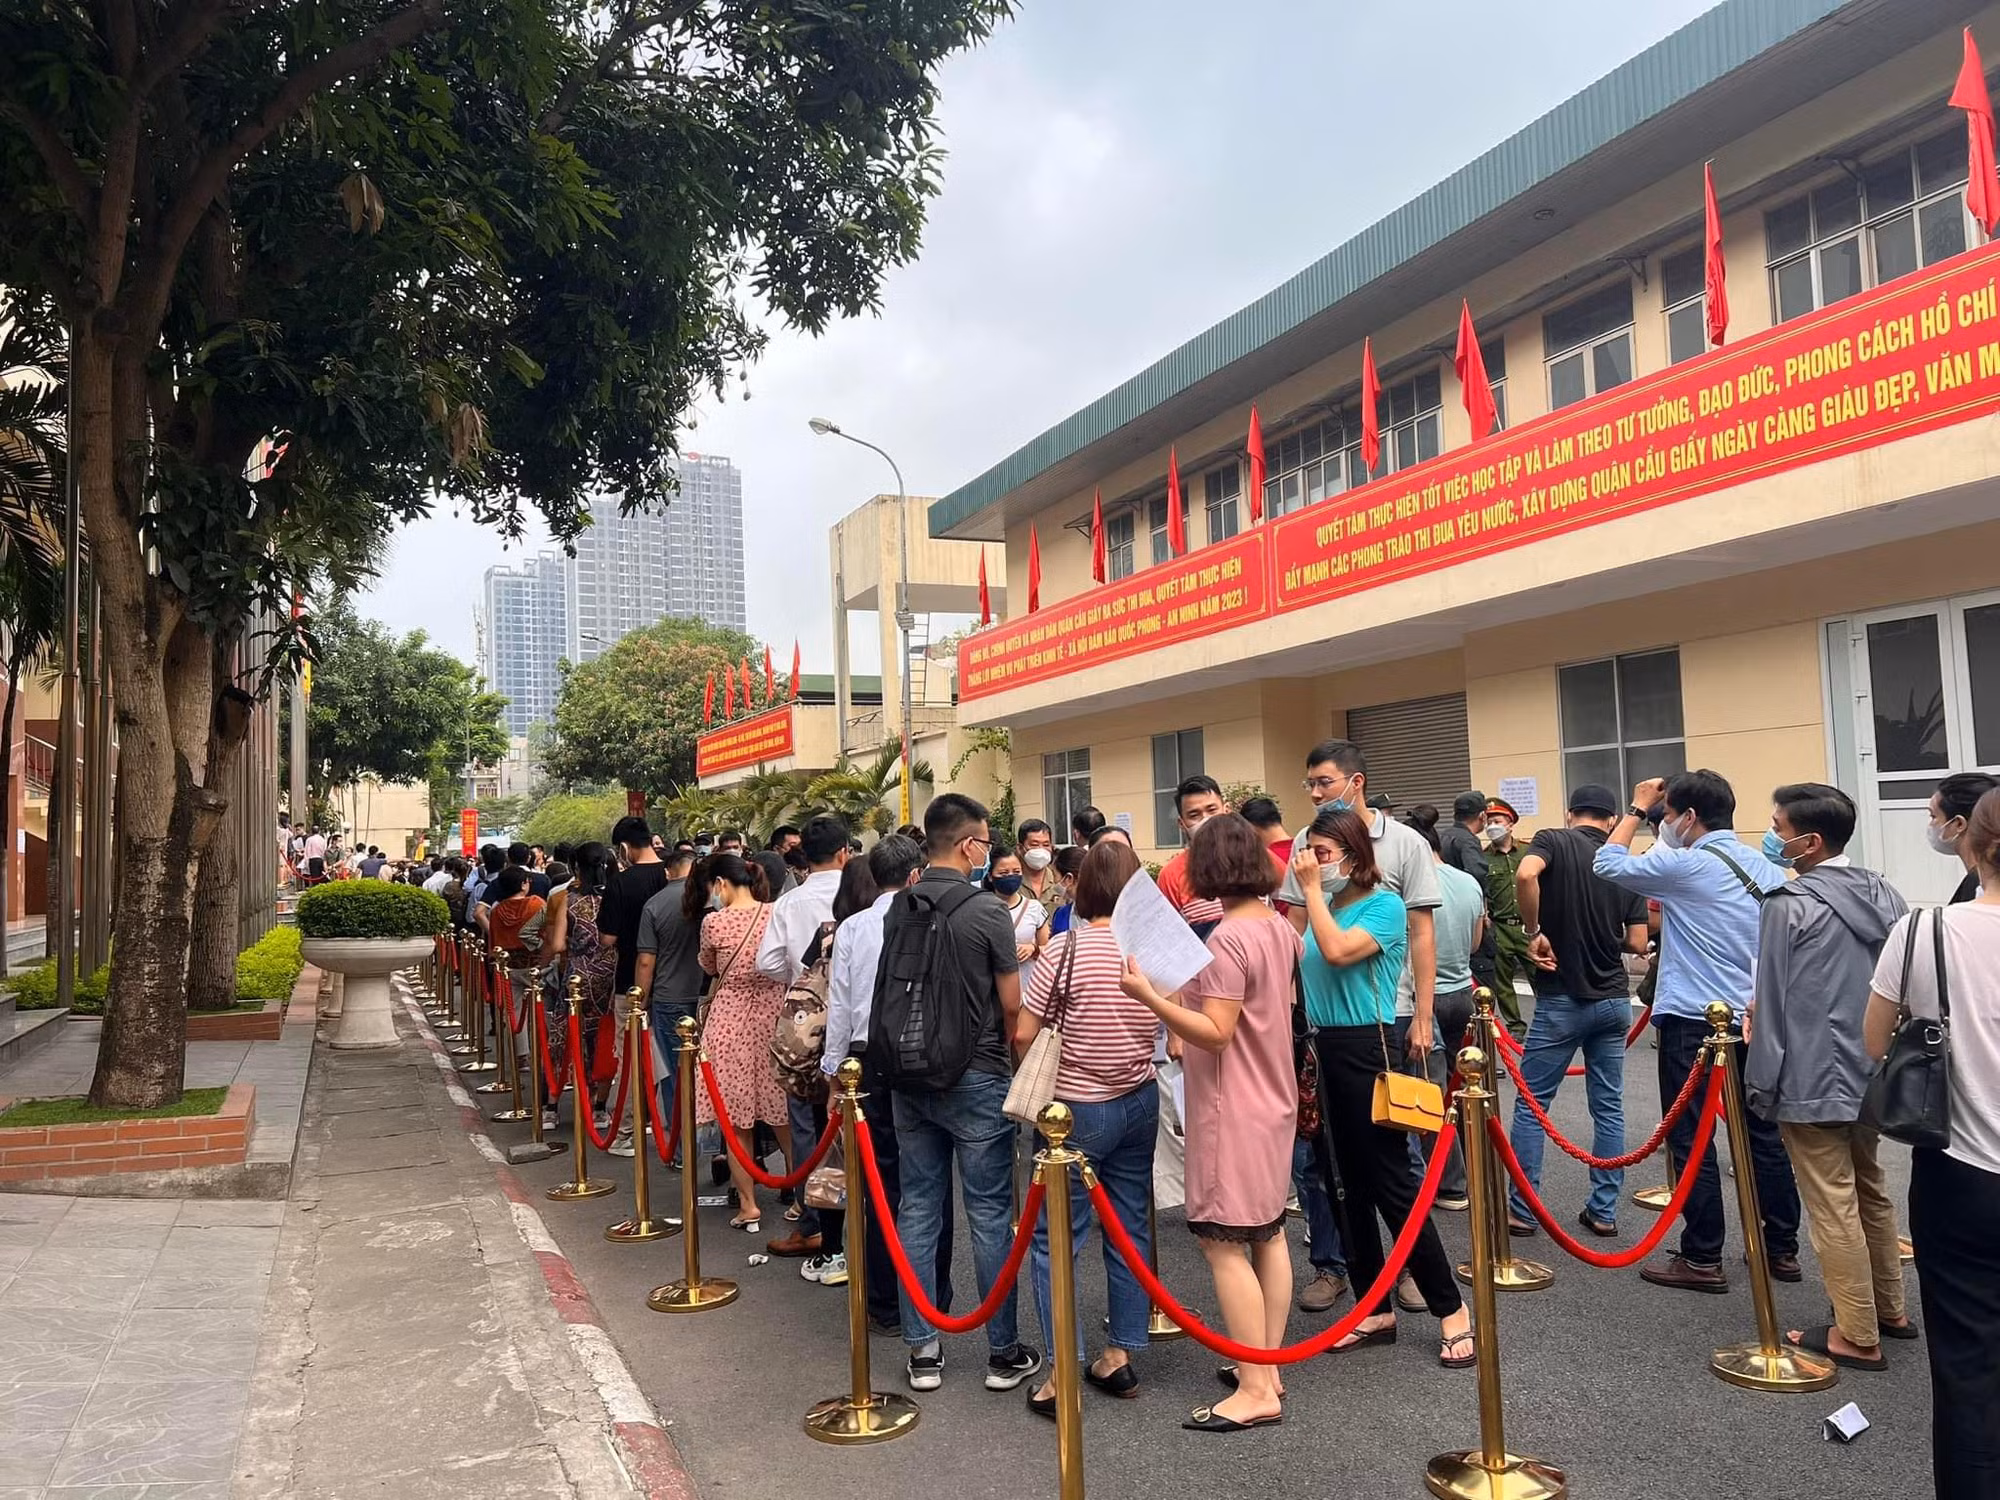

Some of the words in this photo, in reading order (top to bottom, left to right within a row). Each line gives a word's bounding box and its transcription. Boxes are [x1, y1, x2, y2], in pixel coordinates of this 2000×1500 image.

[1303, 558, 1329, 587] MẠNH
[1331, 552, 1349, 579] CÁC
[1351, 541, 1384, 570] PHONG
[1385, 532, 1411, 560] TRÀO
[1413, 528, 1431, 552] THI
[1433, 519, 1455, 546] ĐUA
[1457, 509, 1479, 539] YÊU
[1482, 496, 1519, 532] NƯỚC,
[1521, 487, 1547, 519] XÂY
[1550, 476, 1588, 512] DỰNG
[1591, 460, 1631, 499] QUẬN
[1634, 445, 1666, 484] CẦU
[1670, 430, 1707, 474] GIẤY
[1711, 419, 1758, 462] NGÀY
[1764, 402, 1816, 445] CÀNG
[1821, 384, 1869, 428] GIÀU
[1874, 370, 1920, 413] ĐẸP,
[1924, 351, 1972, 395] VĂN
[1316, 514, 1344, 548] QUYẾT
[1345, 511, 1366, 536] TÂM
[1368, 501, 1393, 530] THỰC
[1396, 491, 1420, 522] HIỆN
[1422, 478, 1441, 508] TỐT
[1444, 472, 1469, 504] VIỆC
[1471, 465, 1496, 496] HỌC
[1498, 454, 1522, 488] TẬP
[1524, 443, 1542, 476] VÀ
[1544, 437, 1574, 469] LÀM
[1577, 423, 1613, 458] THEO
[1616, 411, 1635, 445] TƯ
[1638, 395, 1695, 438] TƯỞNG,
[1698, 380, 1733, 418] ĐẠO
[1738, 364, 1780, 403] ĐỨC,
[1785, 337, 1852, 388] PHONG
[1857, 314, 1915, 363] CÁCH
[1920, 290, 1951, 342] HỒ
[1958, 277, 1997, 328] CHÍ
[1156, 576, 1179, 604] QUYẾT
[1180, 571, 1197, 593] TÂM
[1199, 565, 1220, 589] THỰC
[1222, 556, 1242, 581] HIỆN
[1222, 588, 1242, 611] 2023
